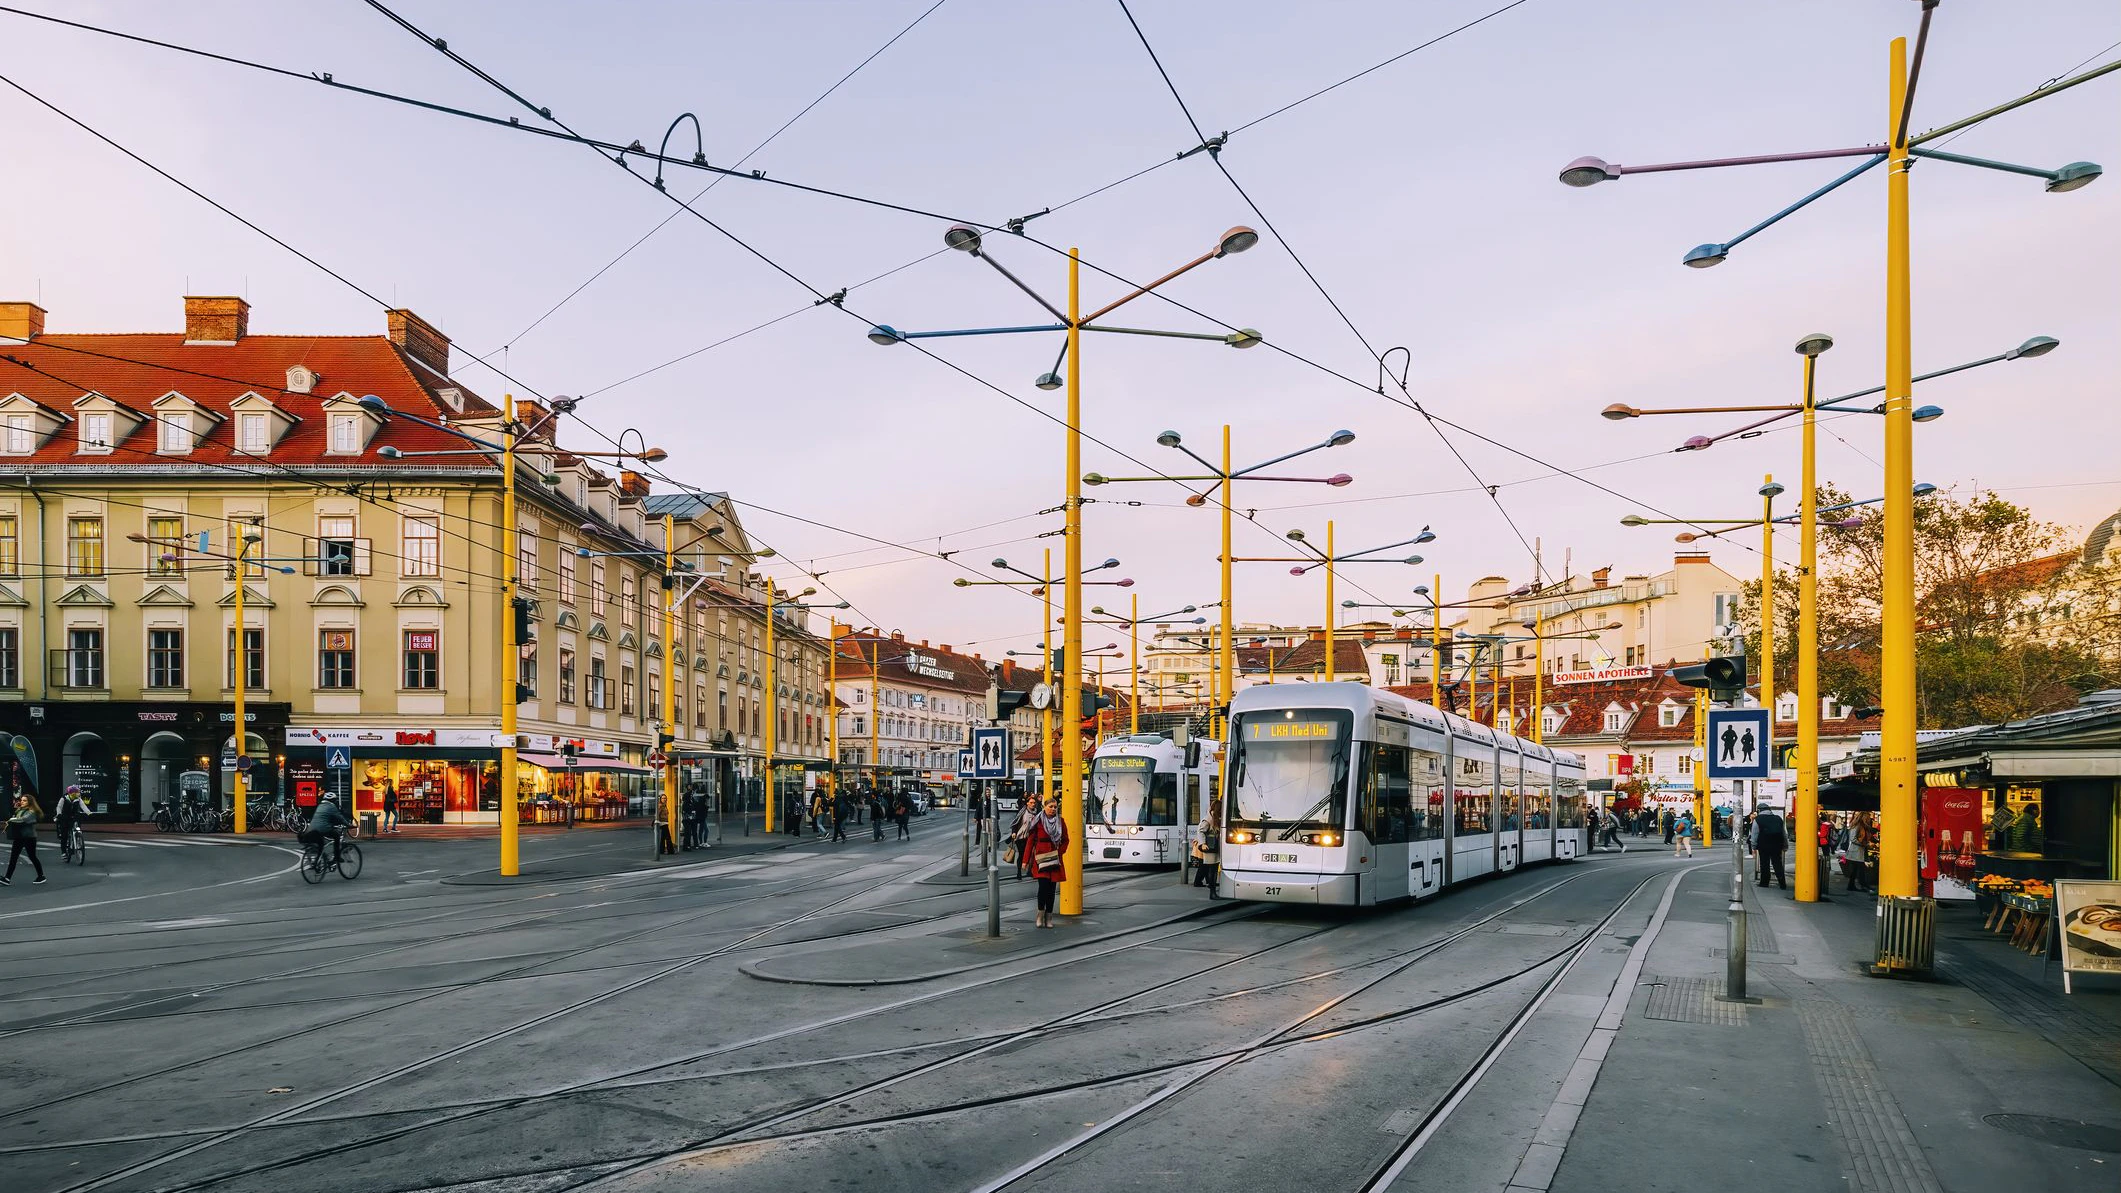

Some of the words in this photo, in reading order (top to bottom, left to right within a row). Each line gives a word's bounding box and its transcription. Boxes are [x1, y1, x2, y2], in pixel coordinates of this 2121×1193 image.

[1556, 671, 1595, 682] SONNEN
[1598, 667, 1649, 679] APOTHEKE
[138, 712, 177, 721] TASTY
[219, 713, 256, 721] DOTS
[1253, 724, 1260, 738] 7
[1271, 724, 1288, 737] LKH
[1291, 724, 1309, 737] Med
[1312, 724, 1328, 736] Uni
[1101, 759, 1106, 768] E
[1649, 793, 1678, 803] Walter
[1262, 854, 1297, 863] GRAZ
[1266, 886, 1281, 895] 217
